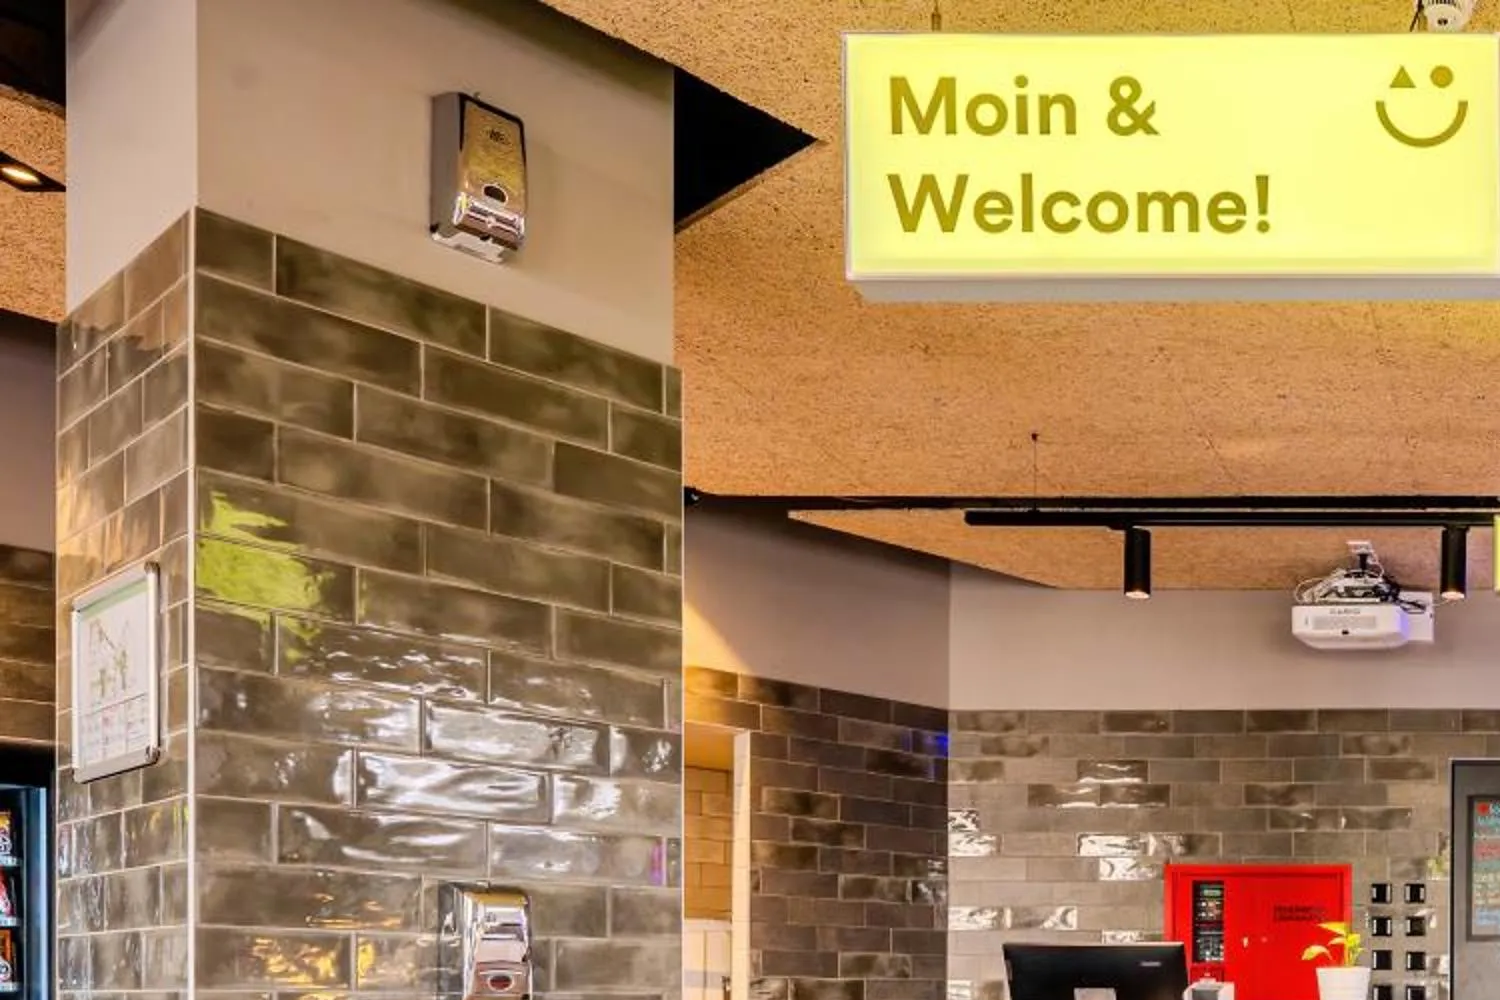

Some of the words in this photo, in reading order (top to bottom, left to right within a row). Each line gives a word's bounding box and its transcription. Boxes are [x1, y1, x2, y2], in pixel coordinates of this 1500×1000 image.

[889, 75, 1077, 137] Moin
[1106, 75, 1160, 137] &
[887, 173, 1271, 235] Welcome!
